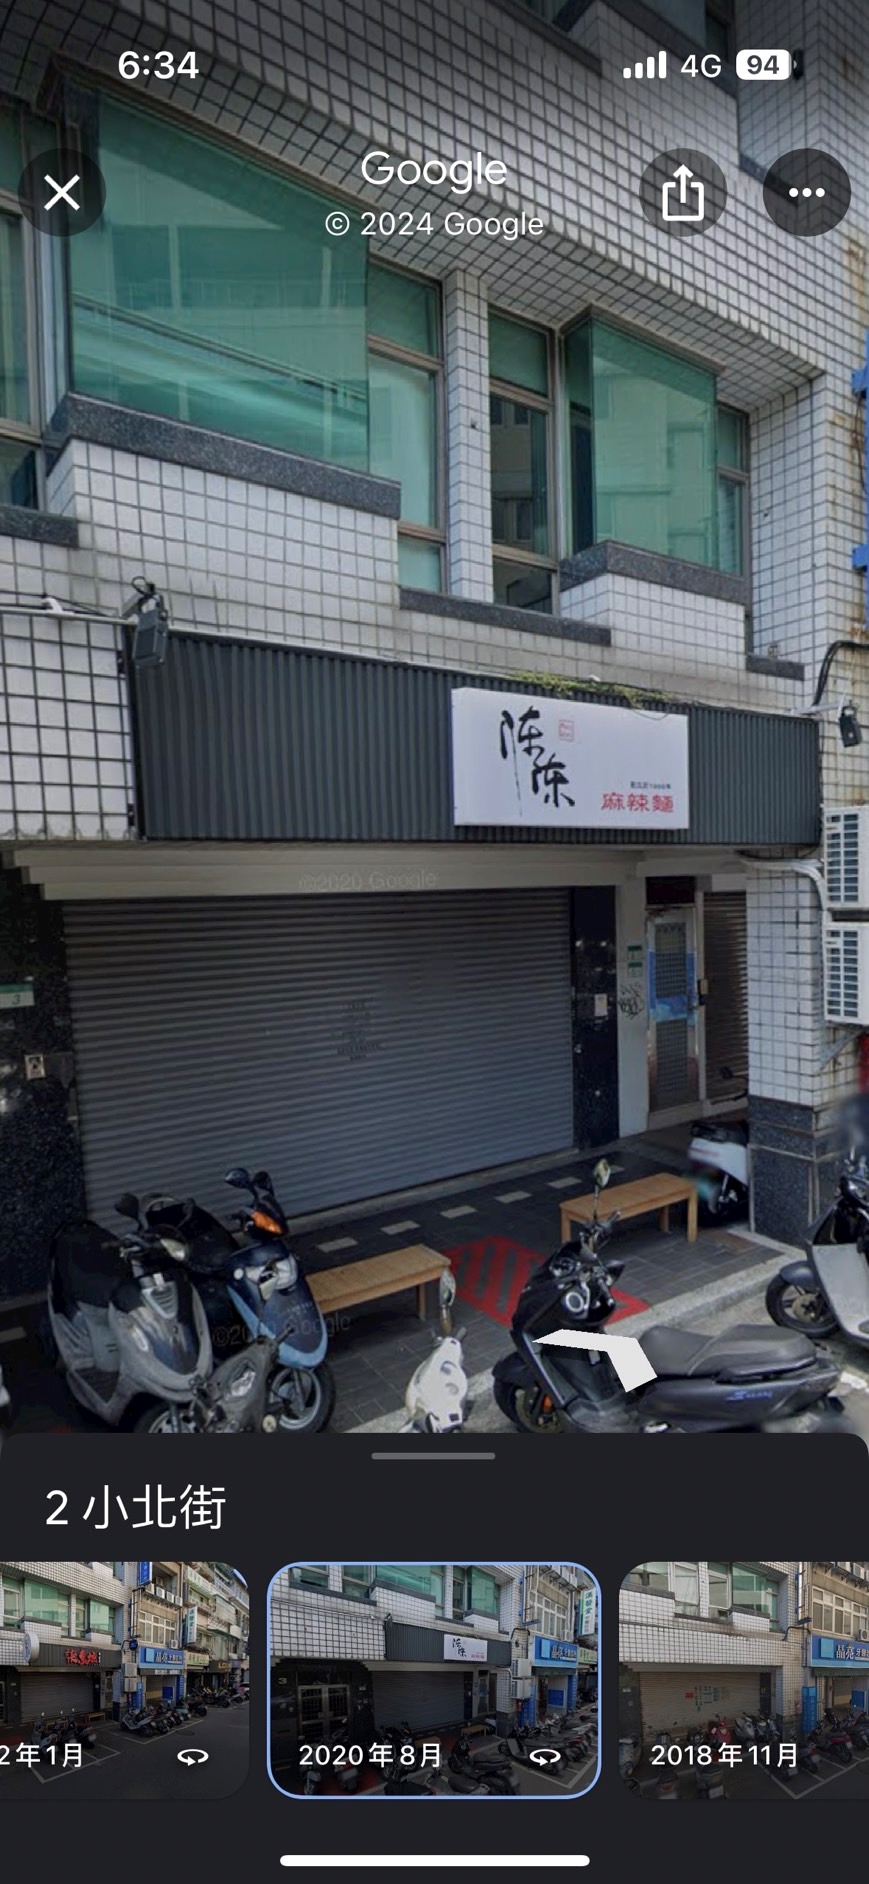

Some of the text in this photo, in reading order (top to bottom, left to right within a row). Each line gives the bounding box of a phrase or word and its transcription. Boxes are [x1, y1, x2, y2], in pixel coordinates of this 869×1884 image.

[601, 792, 674, 813] 麻辣麵
[12, 994, 21, 1005] 3
